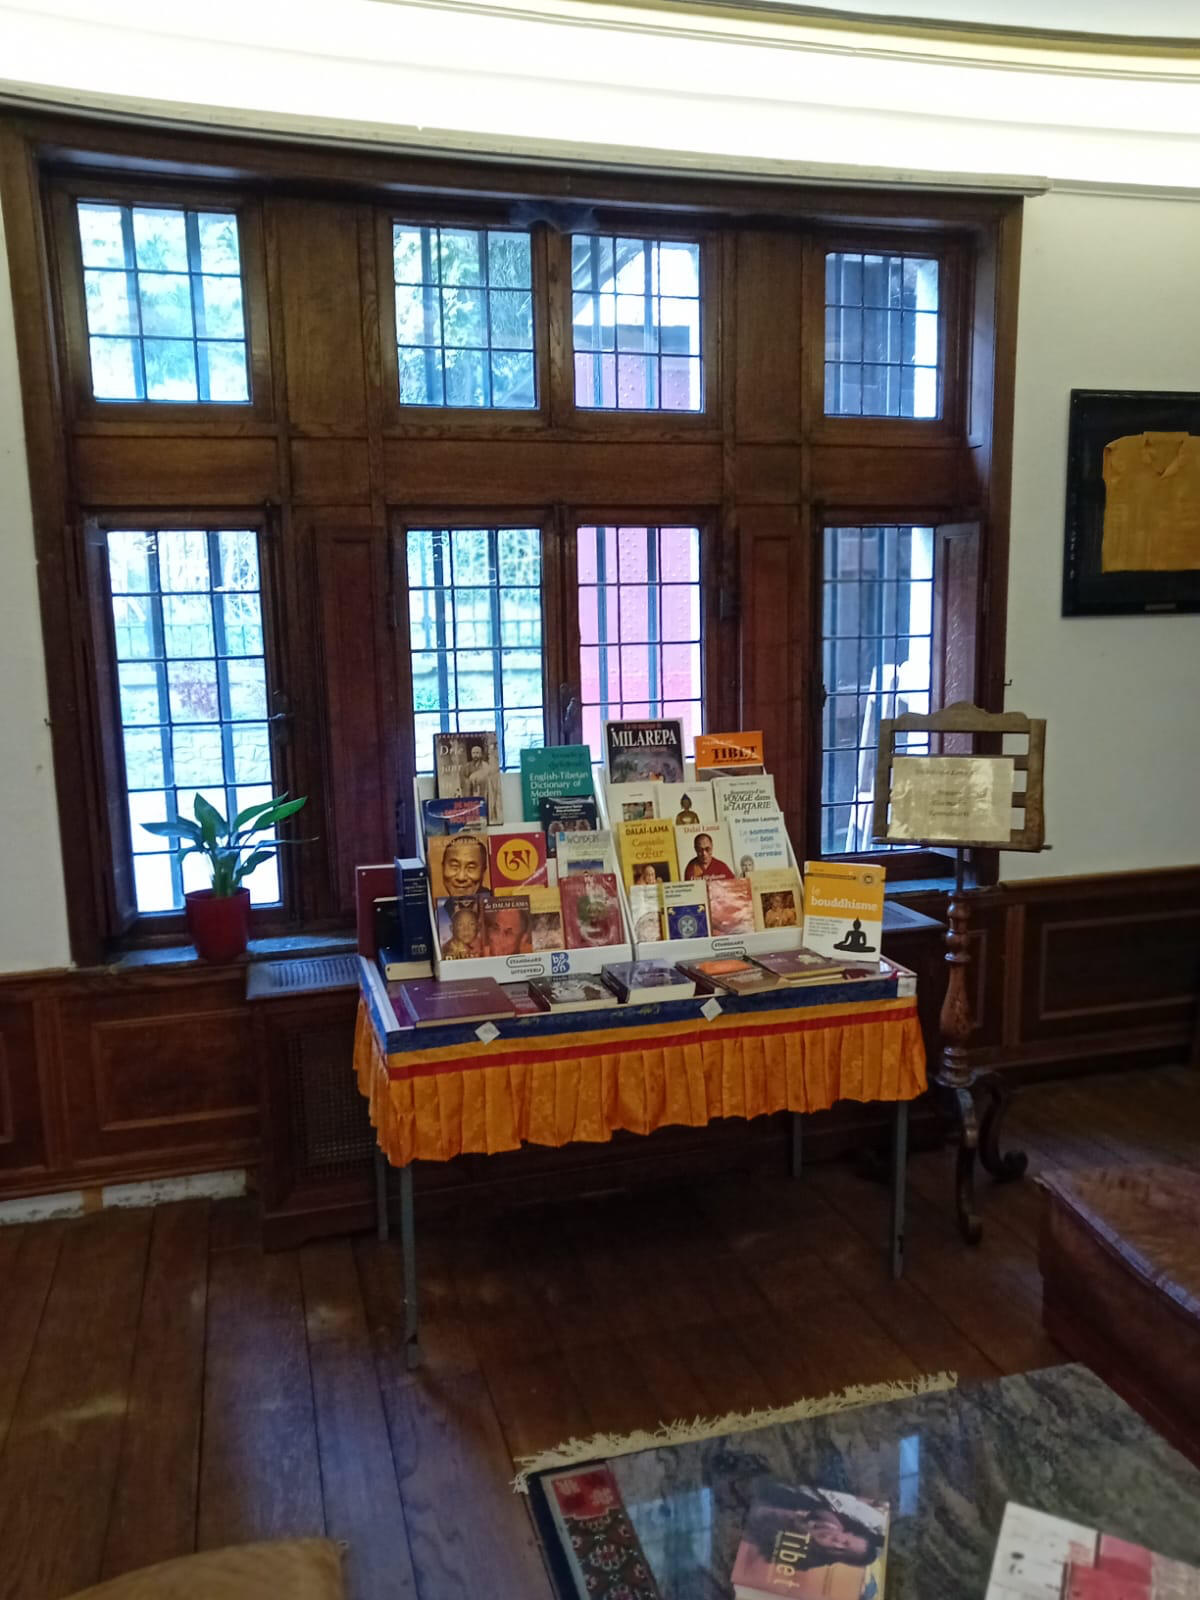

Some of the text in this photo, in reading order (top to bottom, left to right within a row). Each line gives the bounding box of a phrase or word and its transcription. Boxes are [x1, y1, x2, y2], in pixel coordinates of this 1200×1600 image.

[612, 728, 677, 747] MILAREPA
[529, 770, 589, 783] English-Tibetan
[530, 779, 582, 790] Dictionary of
[530, 788, 562, 798] Modern
[811, 885, 821, 896] le
[811, 896, 878, 912] bouddhisme
[774, 1531, 810, 1589] Tibet
